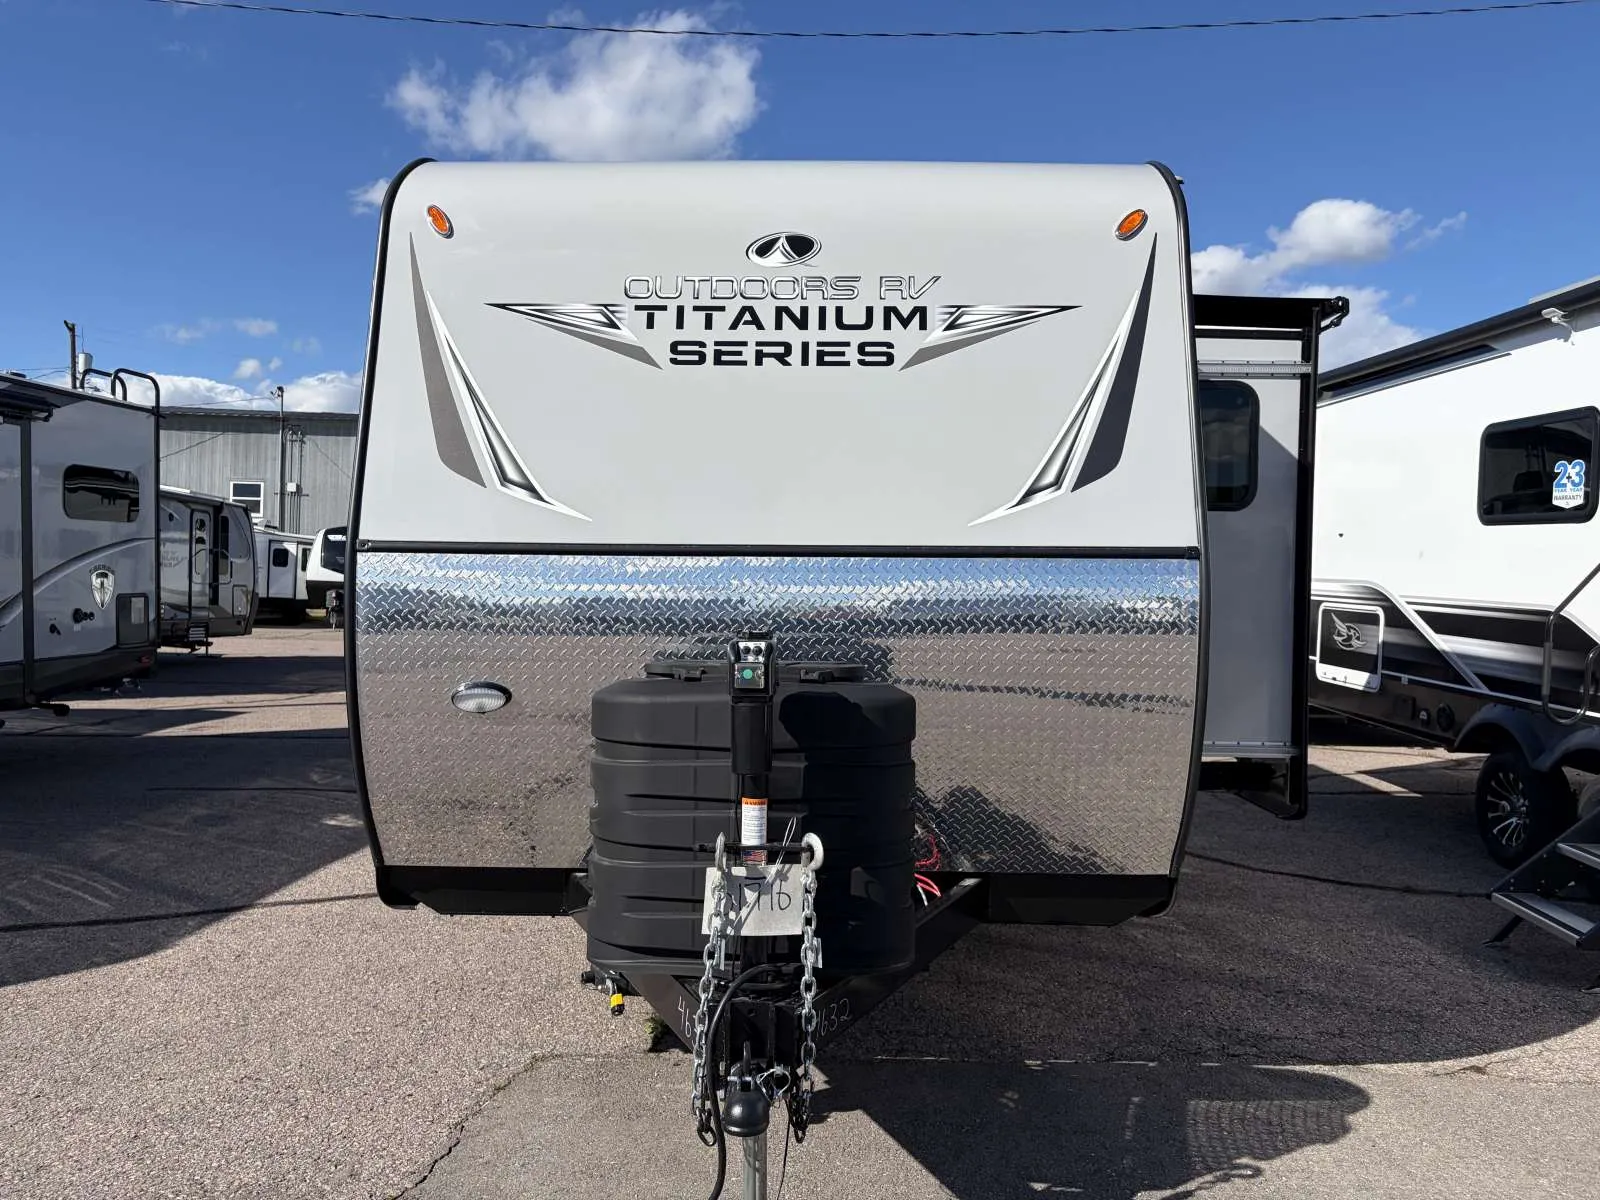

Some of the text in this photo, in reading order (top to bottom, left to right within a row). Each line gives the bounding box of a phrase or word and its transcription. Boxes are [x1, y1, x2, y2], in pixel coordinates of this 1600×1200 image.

[624, 276, 942, 300] OUTDOORS RV
[634, 305, 928, 330] TITANIUM
[669, 341, 895, 366] SERIES
